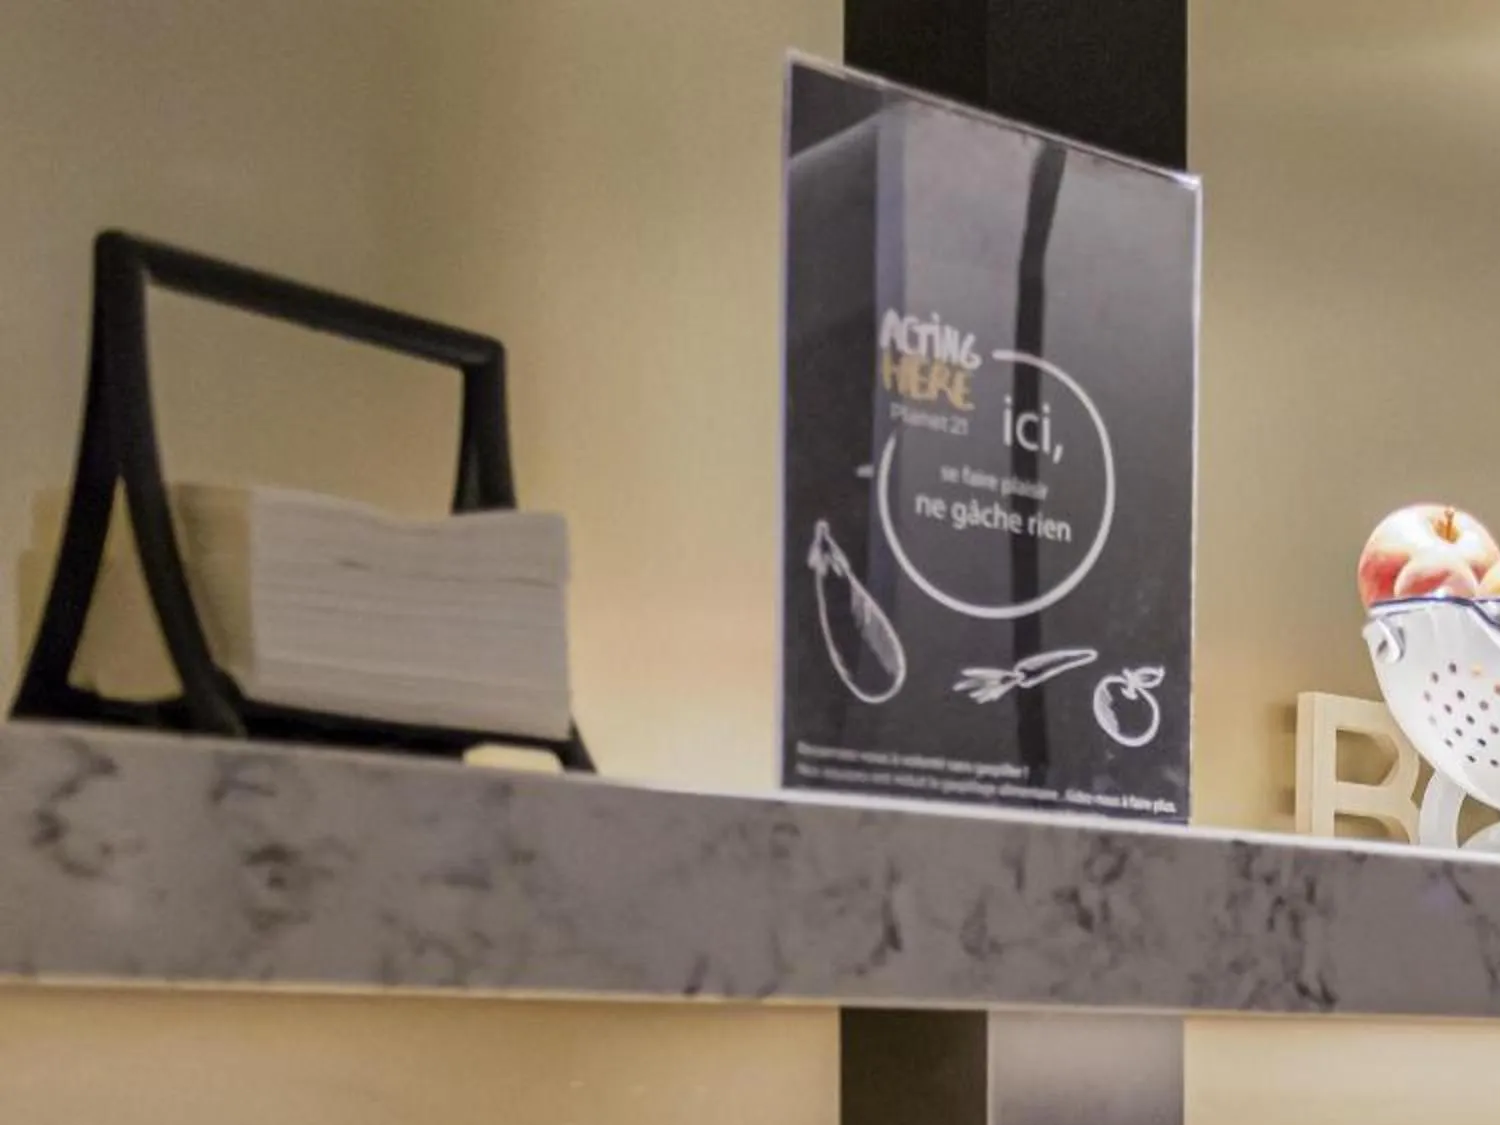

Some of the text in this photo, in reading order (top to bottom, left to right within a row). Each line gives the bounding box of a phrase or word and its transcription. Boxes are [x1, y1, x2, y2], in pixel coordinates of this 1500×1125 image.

[882, 351, 976, 412] HERE
[1003, 394, 1064, 465] ici,
[915, 494, 1072, 543] ne gâche rien
